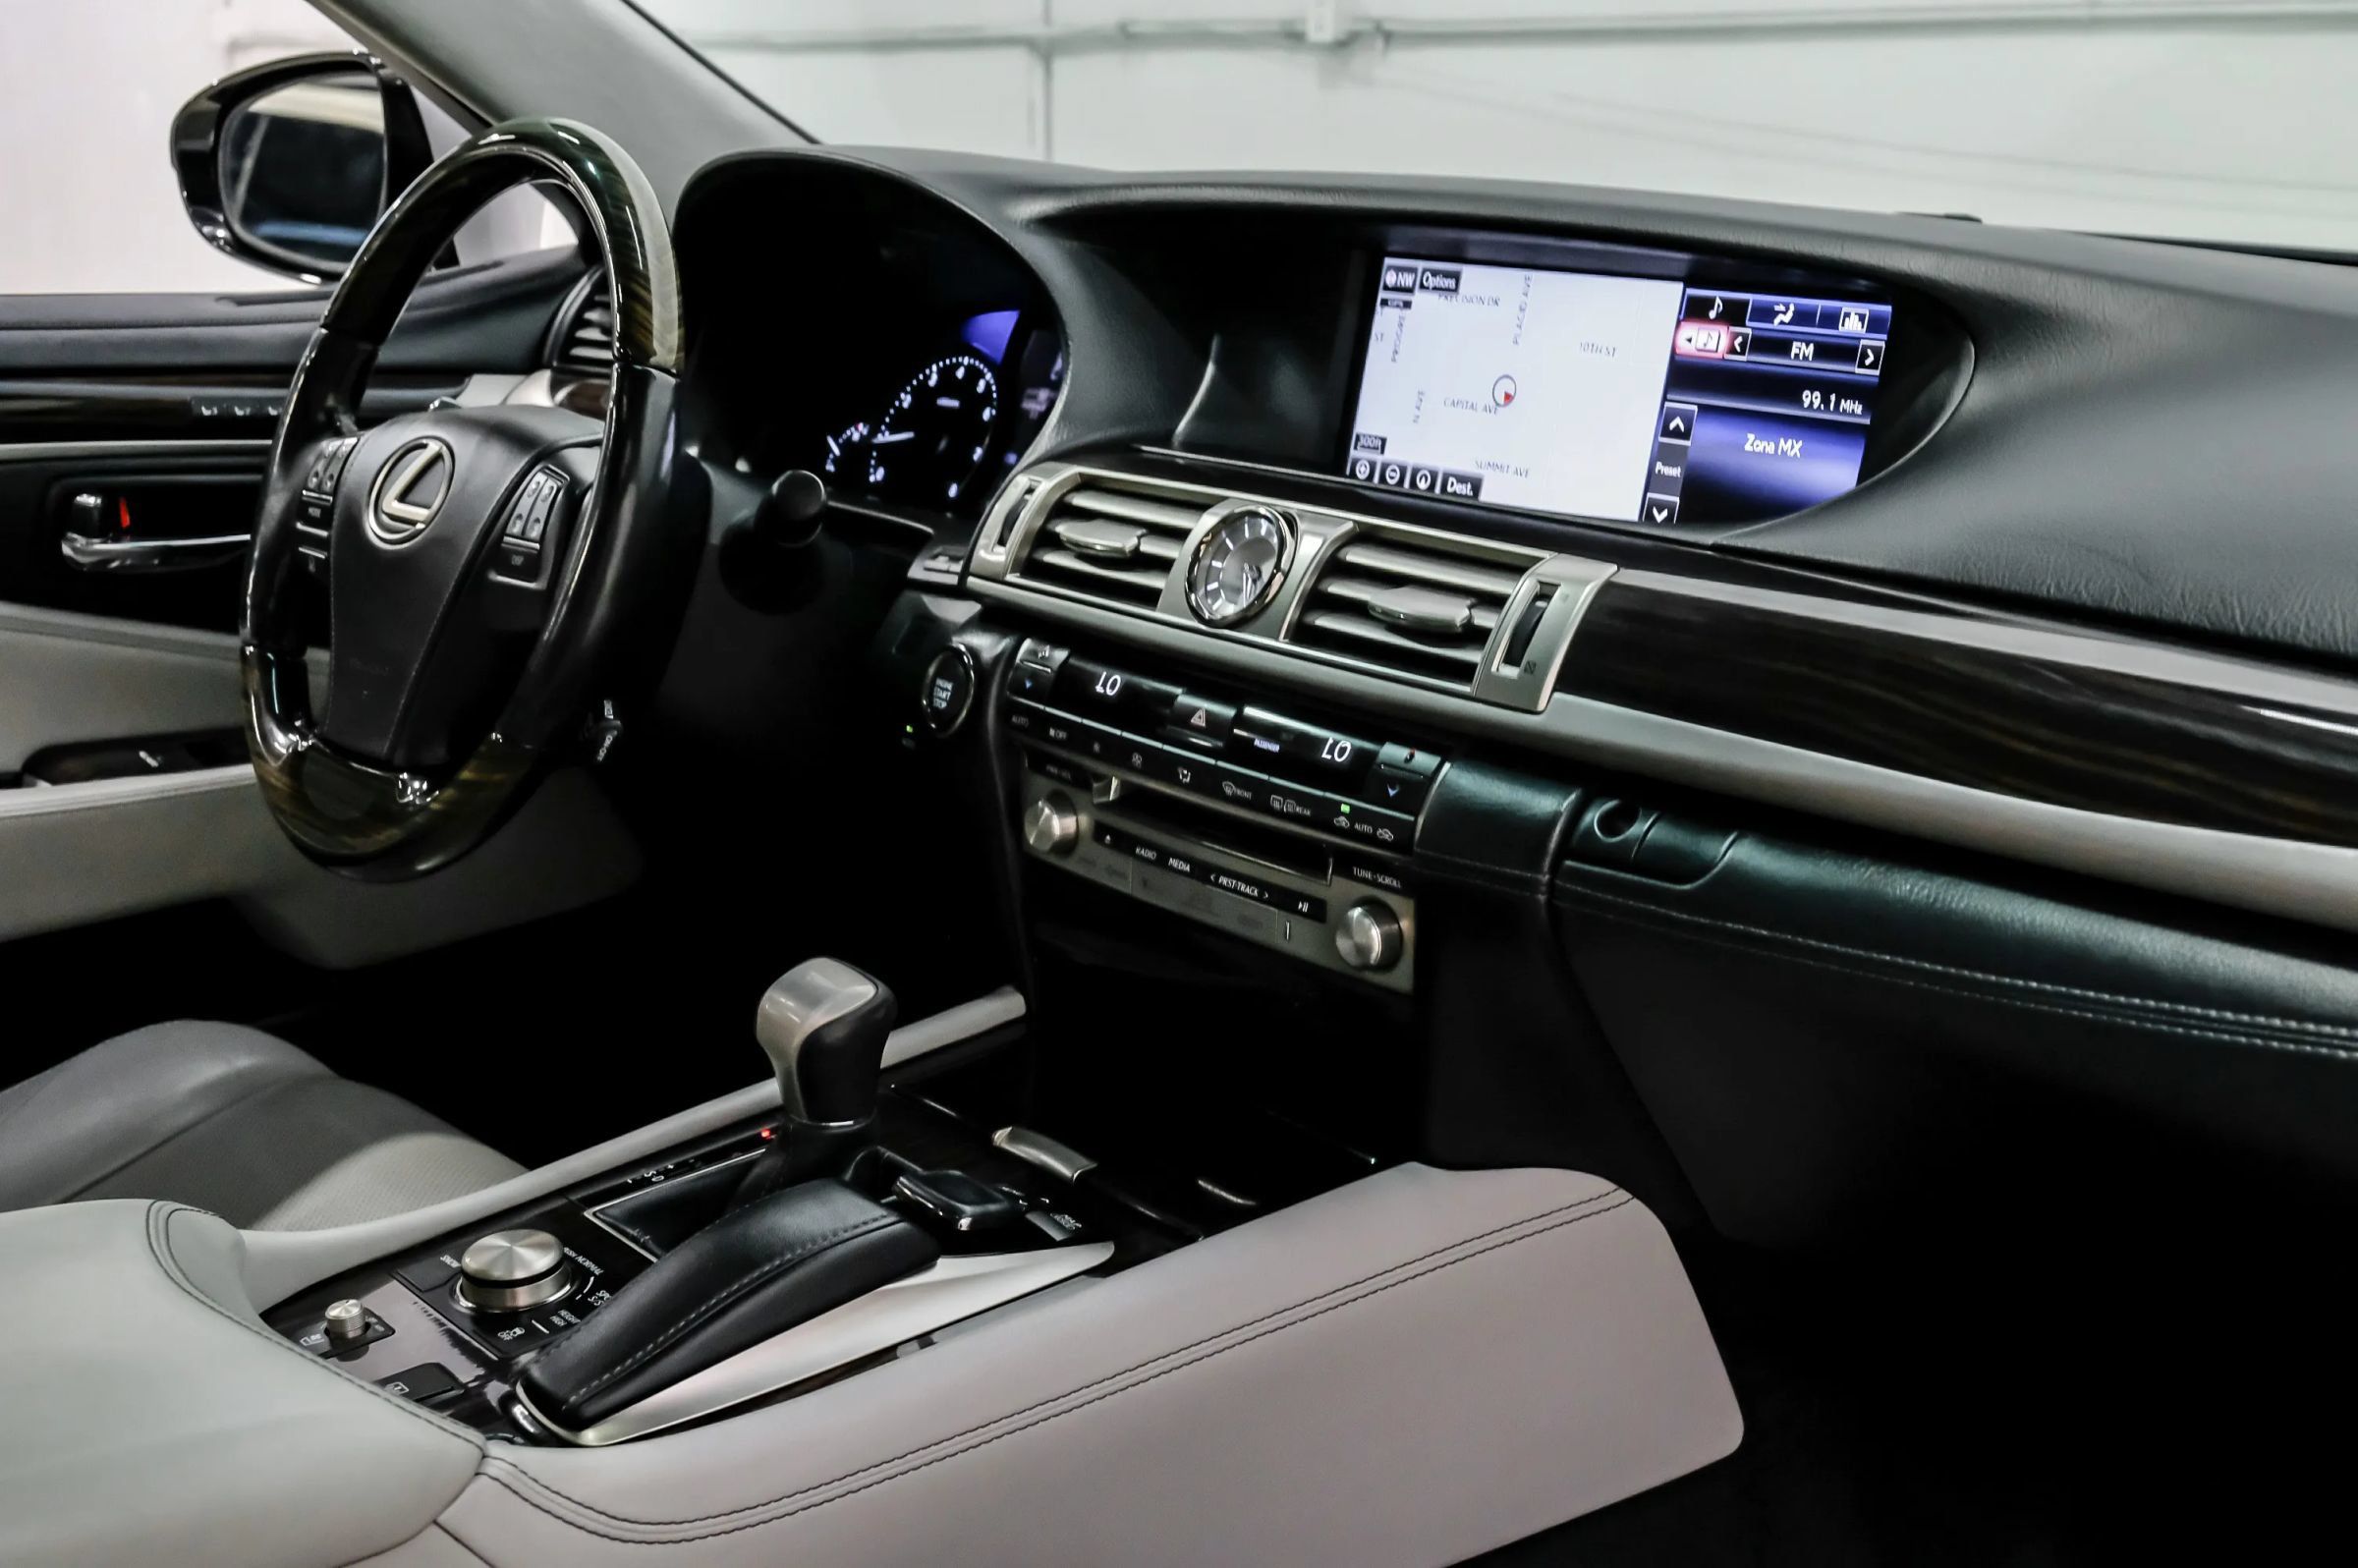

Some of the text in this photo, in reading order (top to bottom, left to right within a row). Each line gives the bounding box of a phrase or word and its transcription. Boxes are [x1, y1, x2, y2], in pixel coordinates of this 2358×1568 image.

[1397, 271, 1416, 288] NW
[1423, 271, 1457, 291] Options
[1790, 341, 1815, 362] FM
[1443, 397, 1479, 413] CAPITAL
[1802, 390, 1862, 416] 99.1 MHz
[1744, 433, 1803, 459] Zona MX
[1655, 461, 1681, 478] Preset
[1446, 476, 1474, 496] Dest.
[1354, 821, 1373, 834] AUTO
[1135, 846, 1157, 861] RADIO
[1168, 857, 1191, 873] MEDIA
